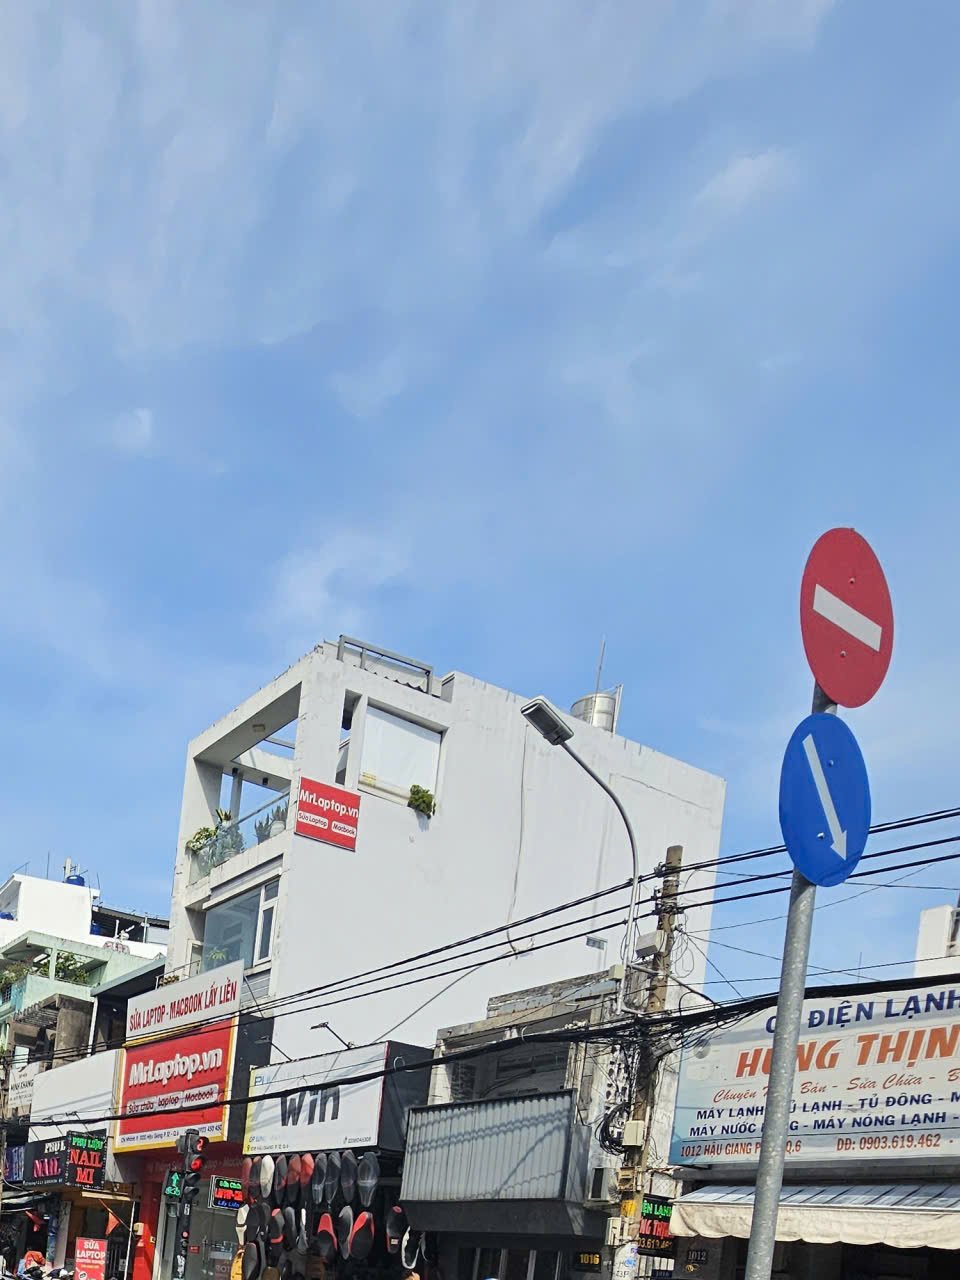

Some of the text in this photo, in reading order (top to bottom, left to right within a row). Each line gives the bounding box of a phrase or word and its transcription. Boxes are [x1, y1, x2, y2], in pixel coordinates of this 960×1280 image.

[300, 789, 359, 818] MrLaptop.vn
[309, 815, 327, 828] Laptop
[333, 823, 355, 835] Macbook
[129, 977, 237, 1031] SỬA LAPTOP MACBOOK LẤY LIỀN
[808, 1000, 874, 1028] ĐIỆN
[884, 989, 960, 1019] LẠNH
[857, 1023, 960, 1068] THỊN
[128, 1047, 223, 1088] MrLaptop.vn
[801, 1081, 827, 1095] Bán
[847, 1077, 877, 1091] Sửa
[883, 1073, 922, 1090] Chữa
[948, 1068, 960, 1082] B
[697, 1107, 724, 1120] MÁY
[729, 1106, 764, 1119] LẠNH
[802, 1100, 842, 1114] LẠNH
[859, 1093, 879, 1109] TỦ
[951, 1091, 960, 1103] M
[690, 1125, 717, 1137] MÁY
[721, 1121, 757, 1135] NƯỚC
[813, 1116, 846, 1130] MÁY
[852, 1114, 895, 1128] NÓNG
[901, 1112, 947, 1127] LẠNH
[69, 1149, 103, 1167] NAIL
[681, 1145, 702, 1157] 1012
[704, 1142, 723, 1159] HẬU
[725, 1142, 752, 1155] GIANG
[837, 1138, 856, 1151] DĐ:
[860, 1133, 941, 1150] 0903.619.462
[33, 1157, 61, 1178] NAIL
[76, 1167, 94, 1184] MI
[76, 1250, 105, 1259] LAPTOP
[580, 1254, 600, 1264] 1016
[688, 1251, 706, 1260] 1012
